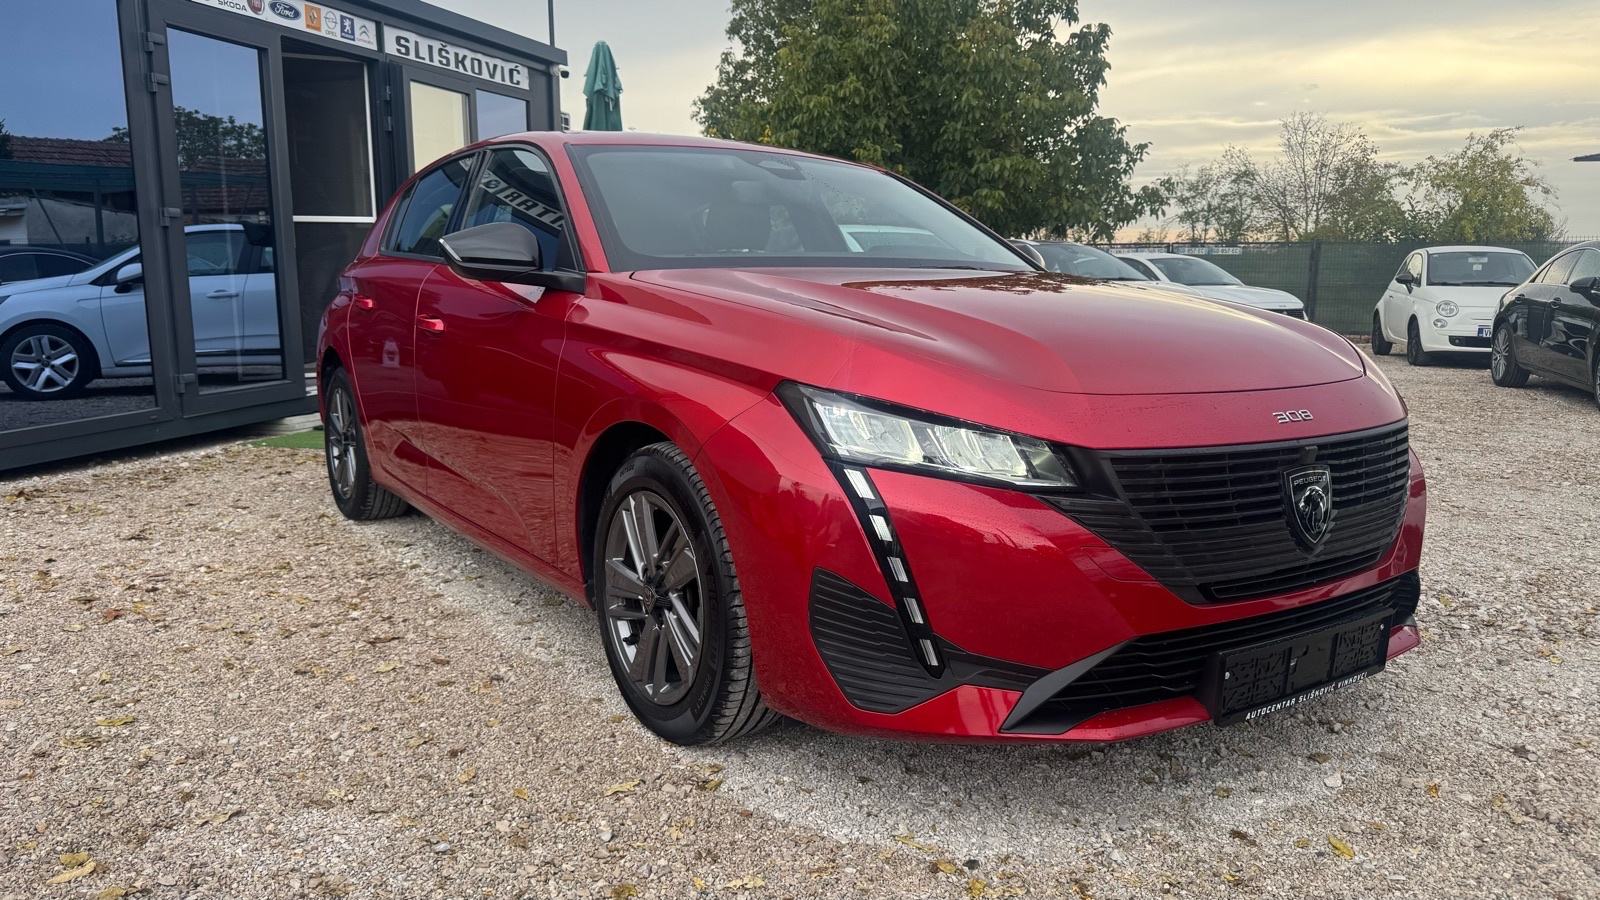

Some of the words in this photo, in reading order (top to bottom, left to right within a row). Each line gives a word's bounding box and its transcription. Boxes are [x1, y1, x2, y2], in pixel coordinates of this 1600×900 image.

[275, 2, 295, 18] Ford
[395, 35, 521, 86] SLIŠKOVIĆ
[1272, 409, 1314, 424] 308
[1293, 475, 1327, 486] PEUGEOT
[1245, 697, 1296, 720] AUTOCENTAR
[1298, 682, 1336, 703] SLIŠKOVIĆ
[1338, 671, 1368, 689] VINKOVCI
